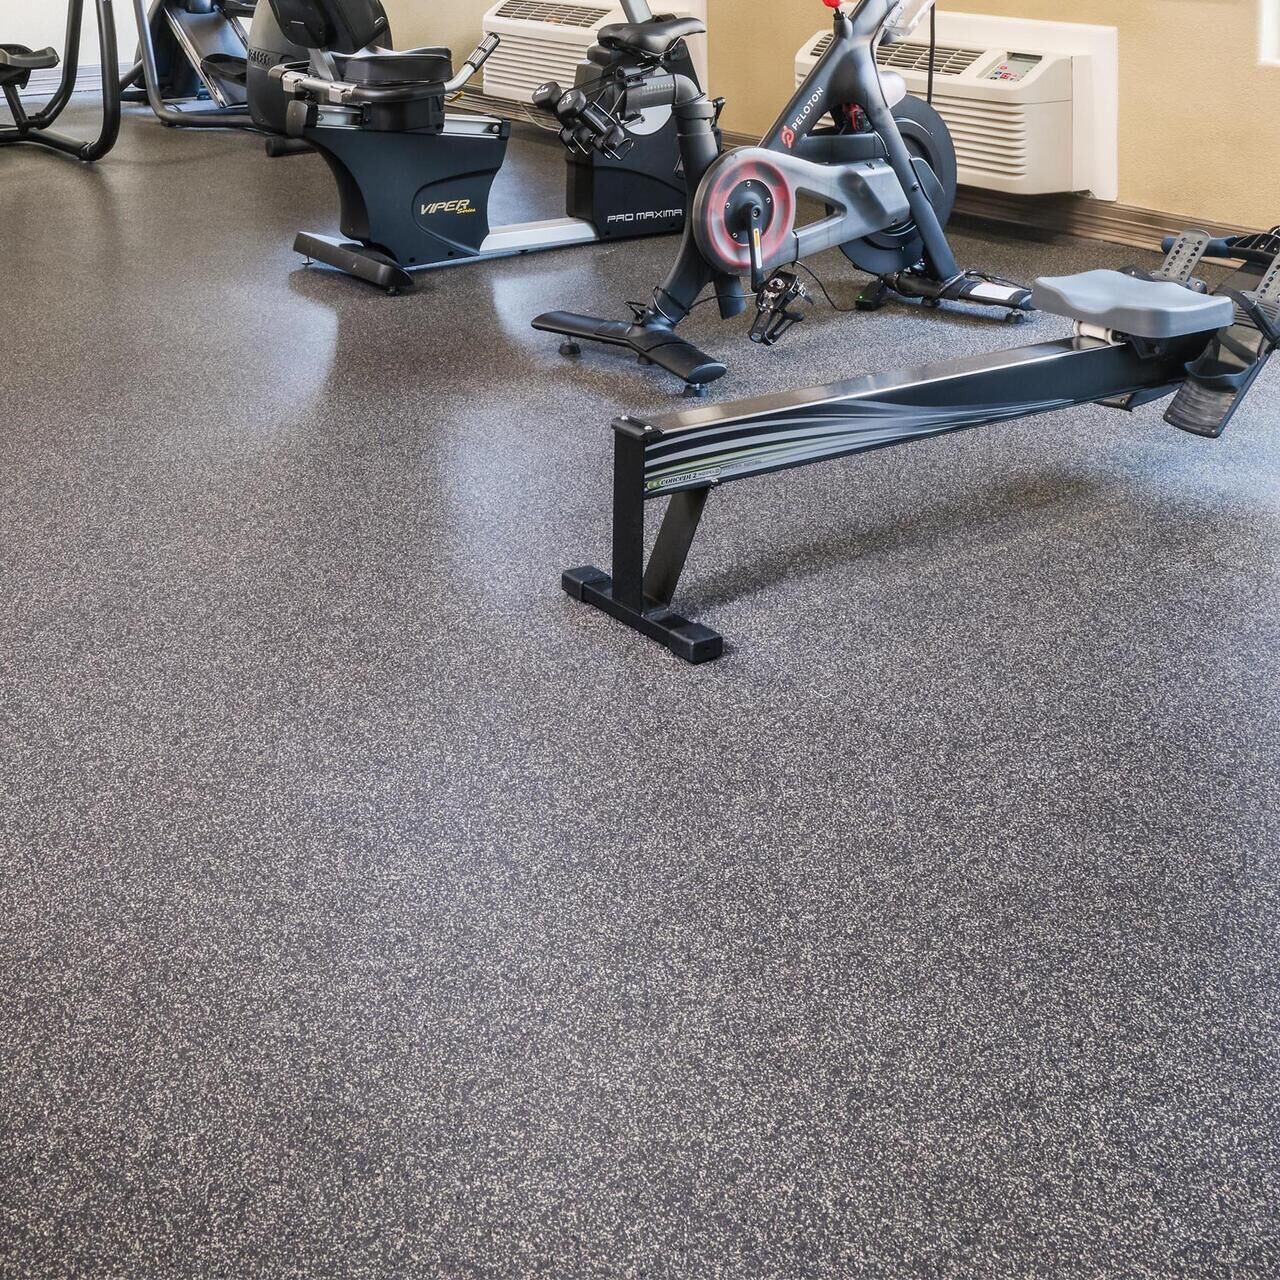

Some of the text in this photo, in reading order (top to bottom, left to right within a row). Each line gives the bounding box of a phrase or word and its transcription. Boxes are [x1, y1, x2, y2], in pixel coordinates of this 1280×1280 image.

[791, 86, 824, 131] PELOTON
[421, 199, 470, 215] VIPER
[636, 208, 683, 221] MAXIMA
